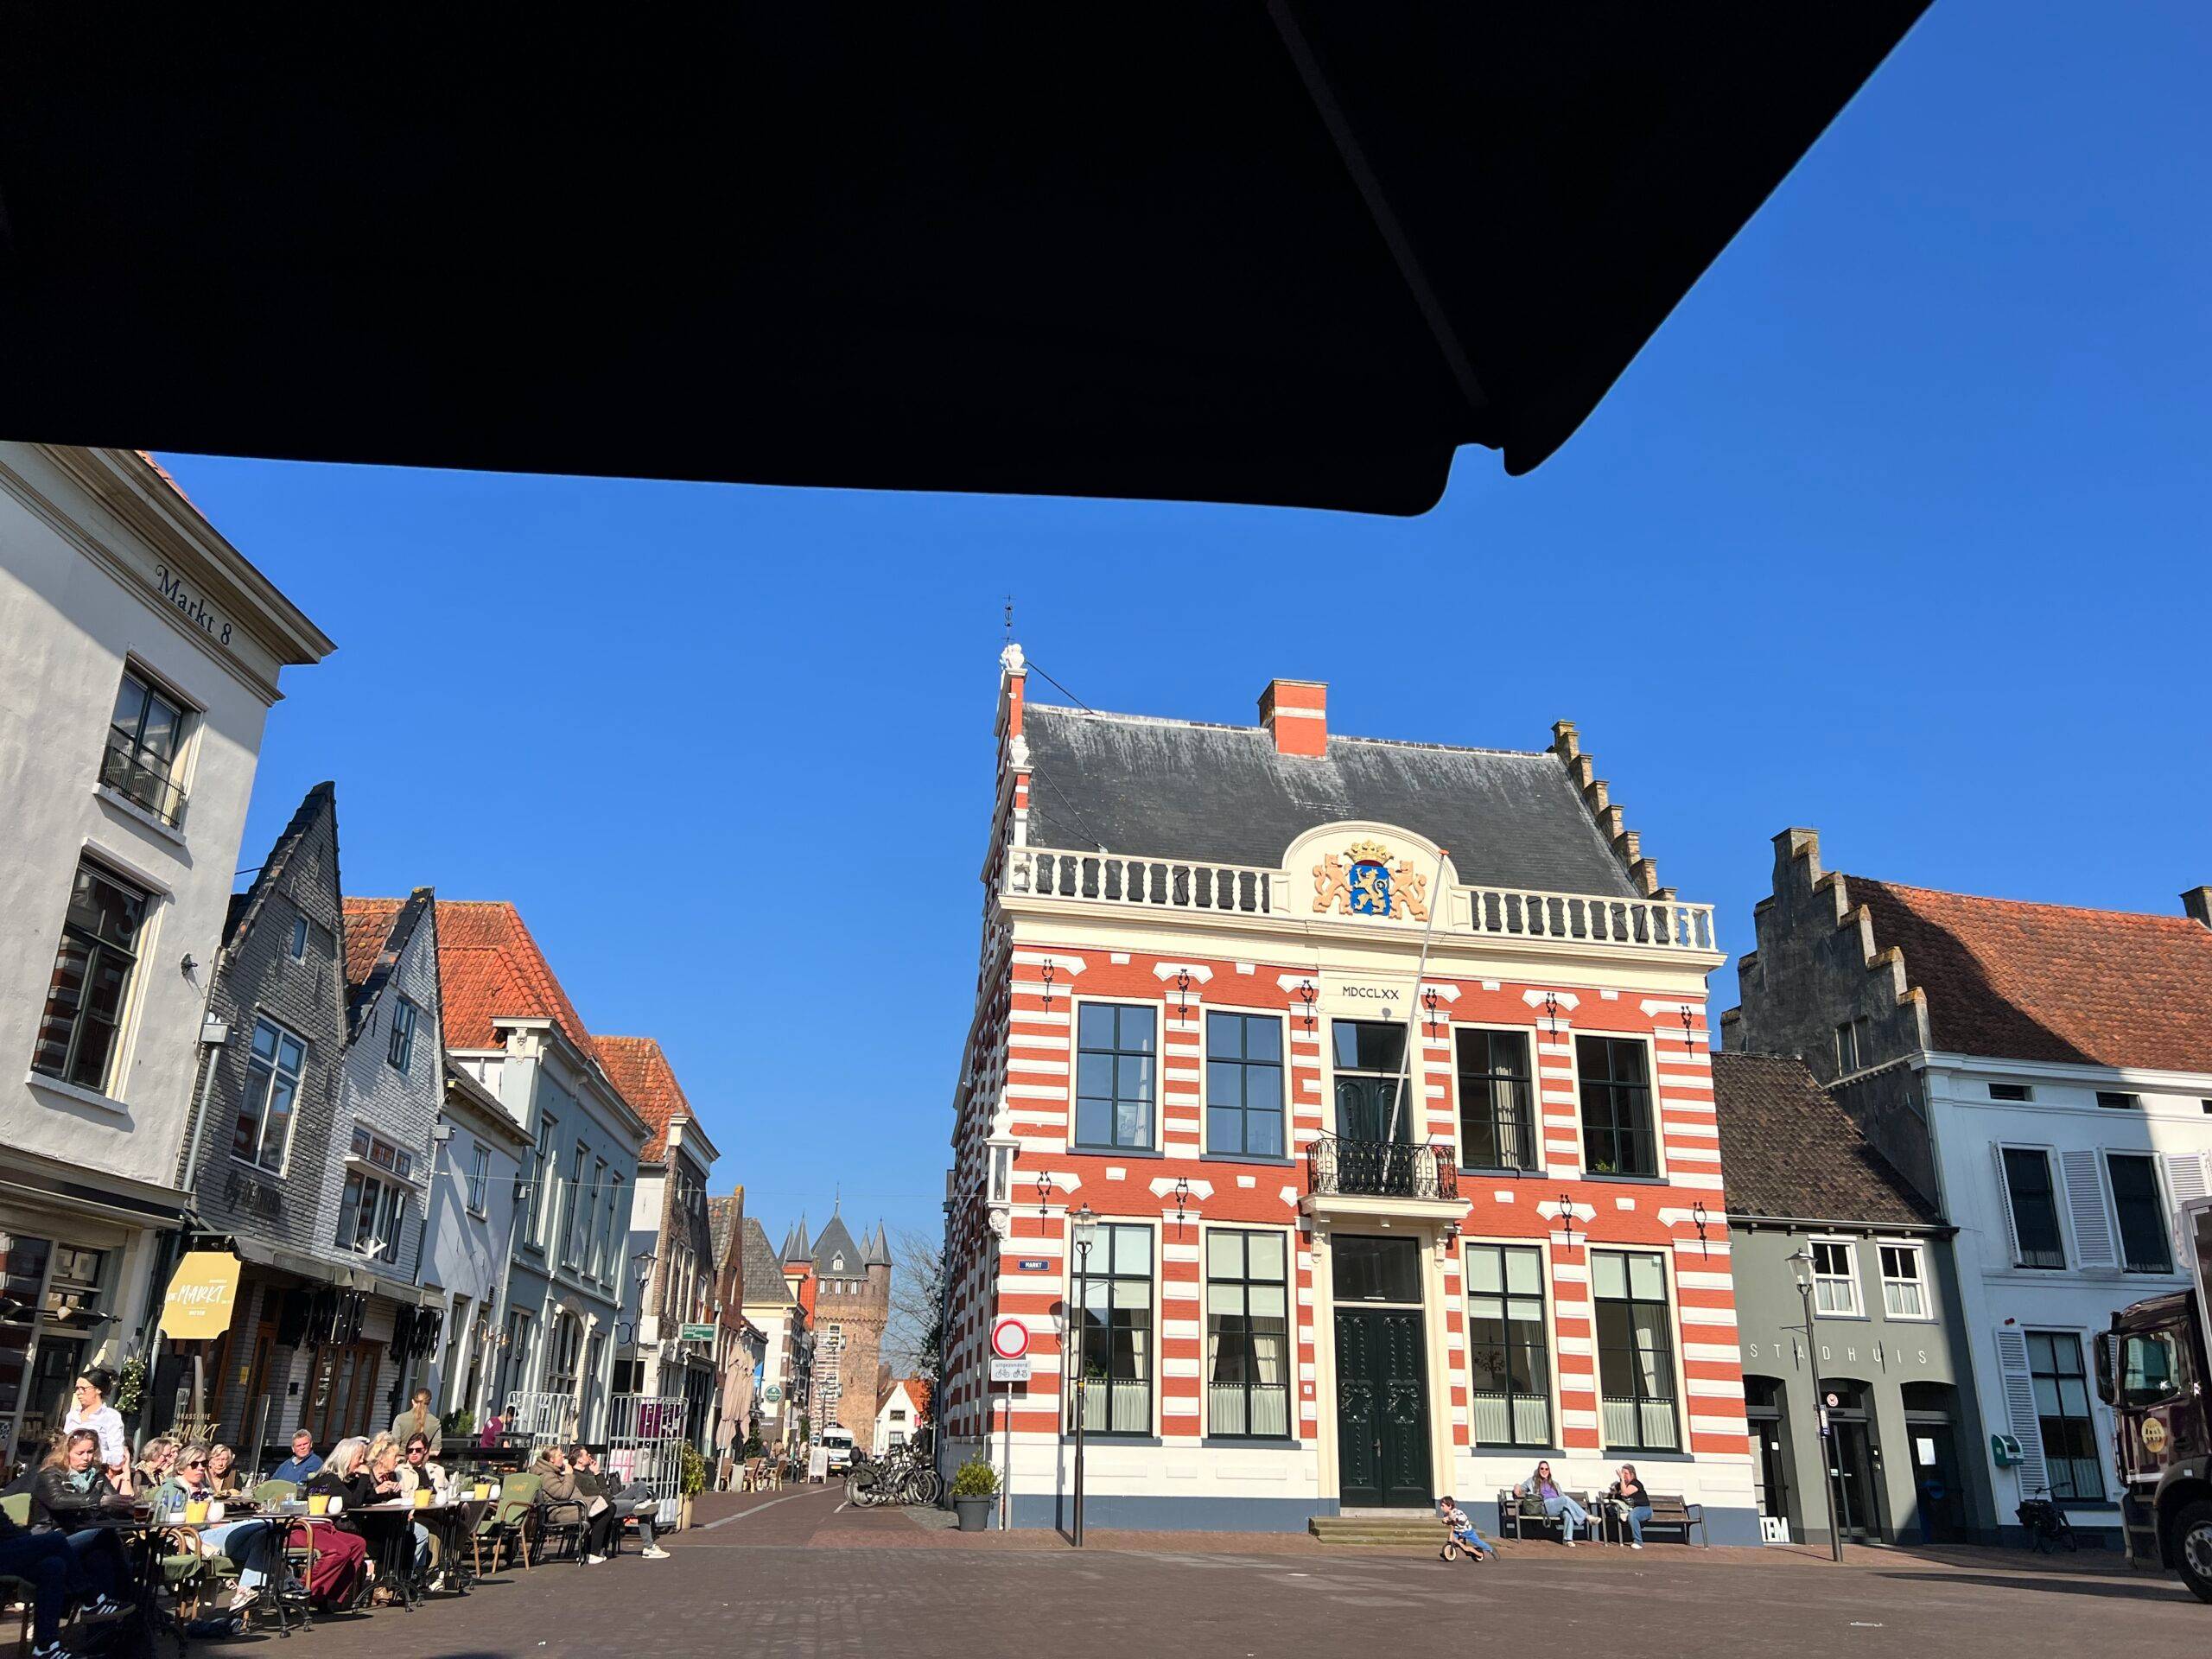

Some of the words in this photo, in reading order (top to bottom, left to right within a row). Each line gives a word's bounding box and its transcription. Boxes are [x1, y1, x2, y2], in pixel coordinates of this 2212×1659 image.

[156, 564, 215, 633] Markt
[220, 623, 232, 645] 8
[1342, 986, 1399, 1000] MDCCLXX
[176, 1284, 228, 1305] MARKT
[1750, 1344, 1927, 1364] STADHUIS
